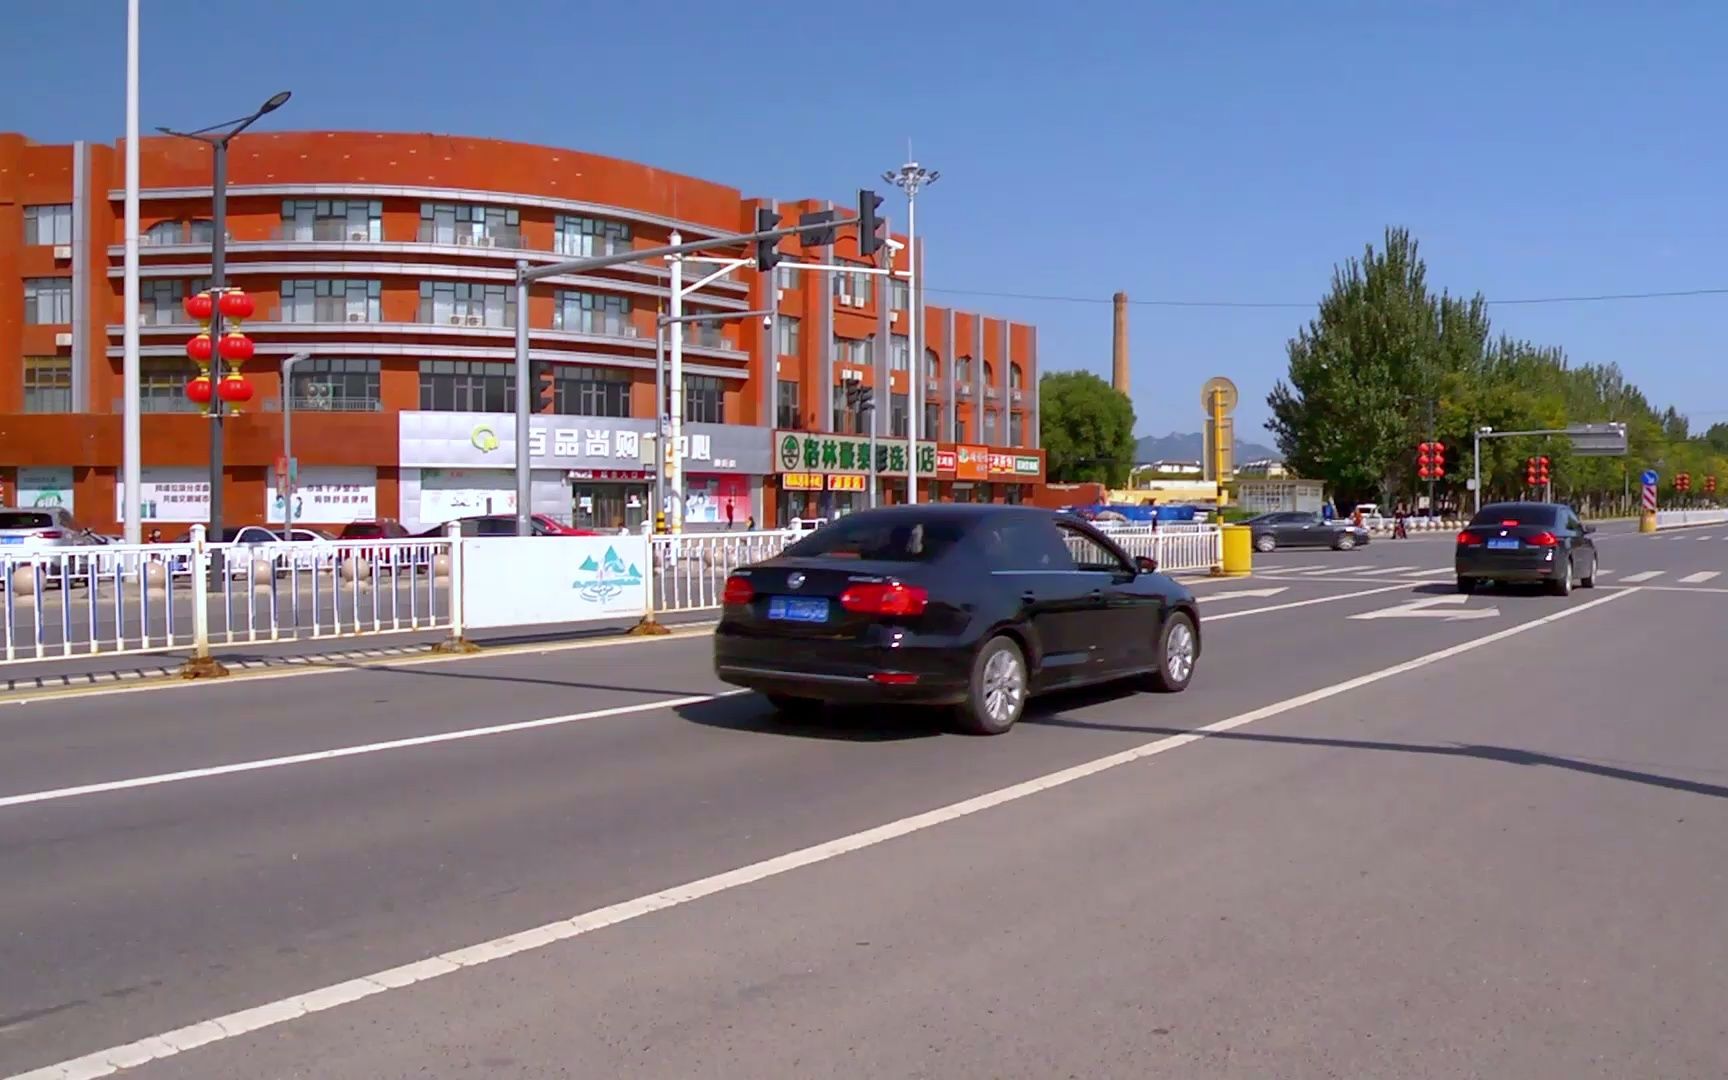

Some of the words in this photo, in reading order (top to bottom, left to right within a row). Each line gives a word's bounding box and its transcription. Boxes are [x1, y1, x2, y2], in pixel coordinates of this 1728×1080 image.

[529, 428, 711, 460] 百品尚购心
